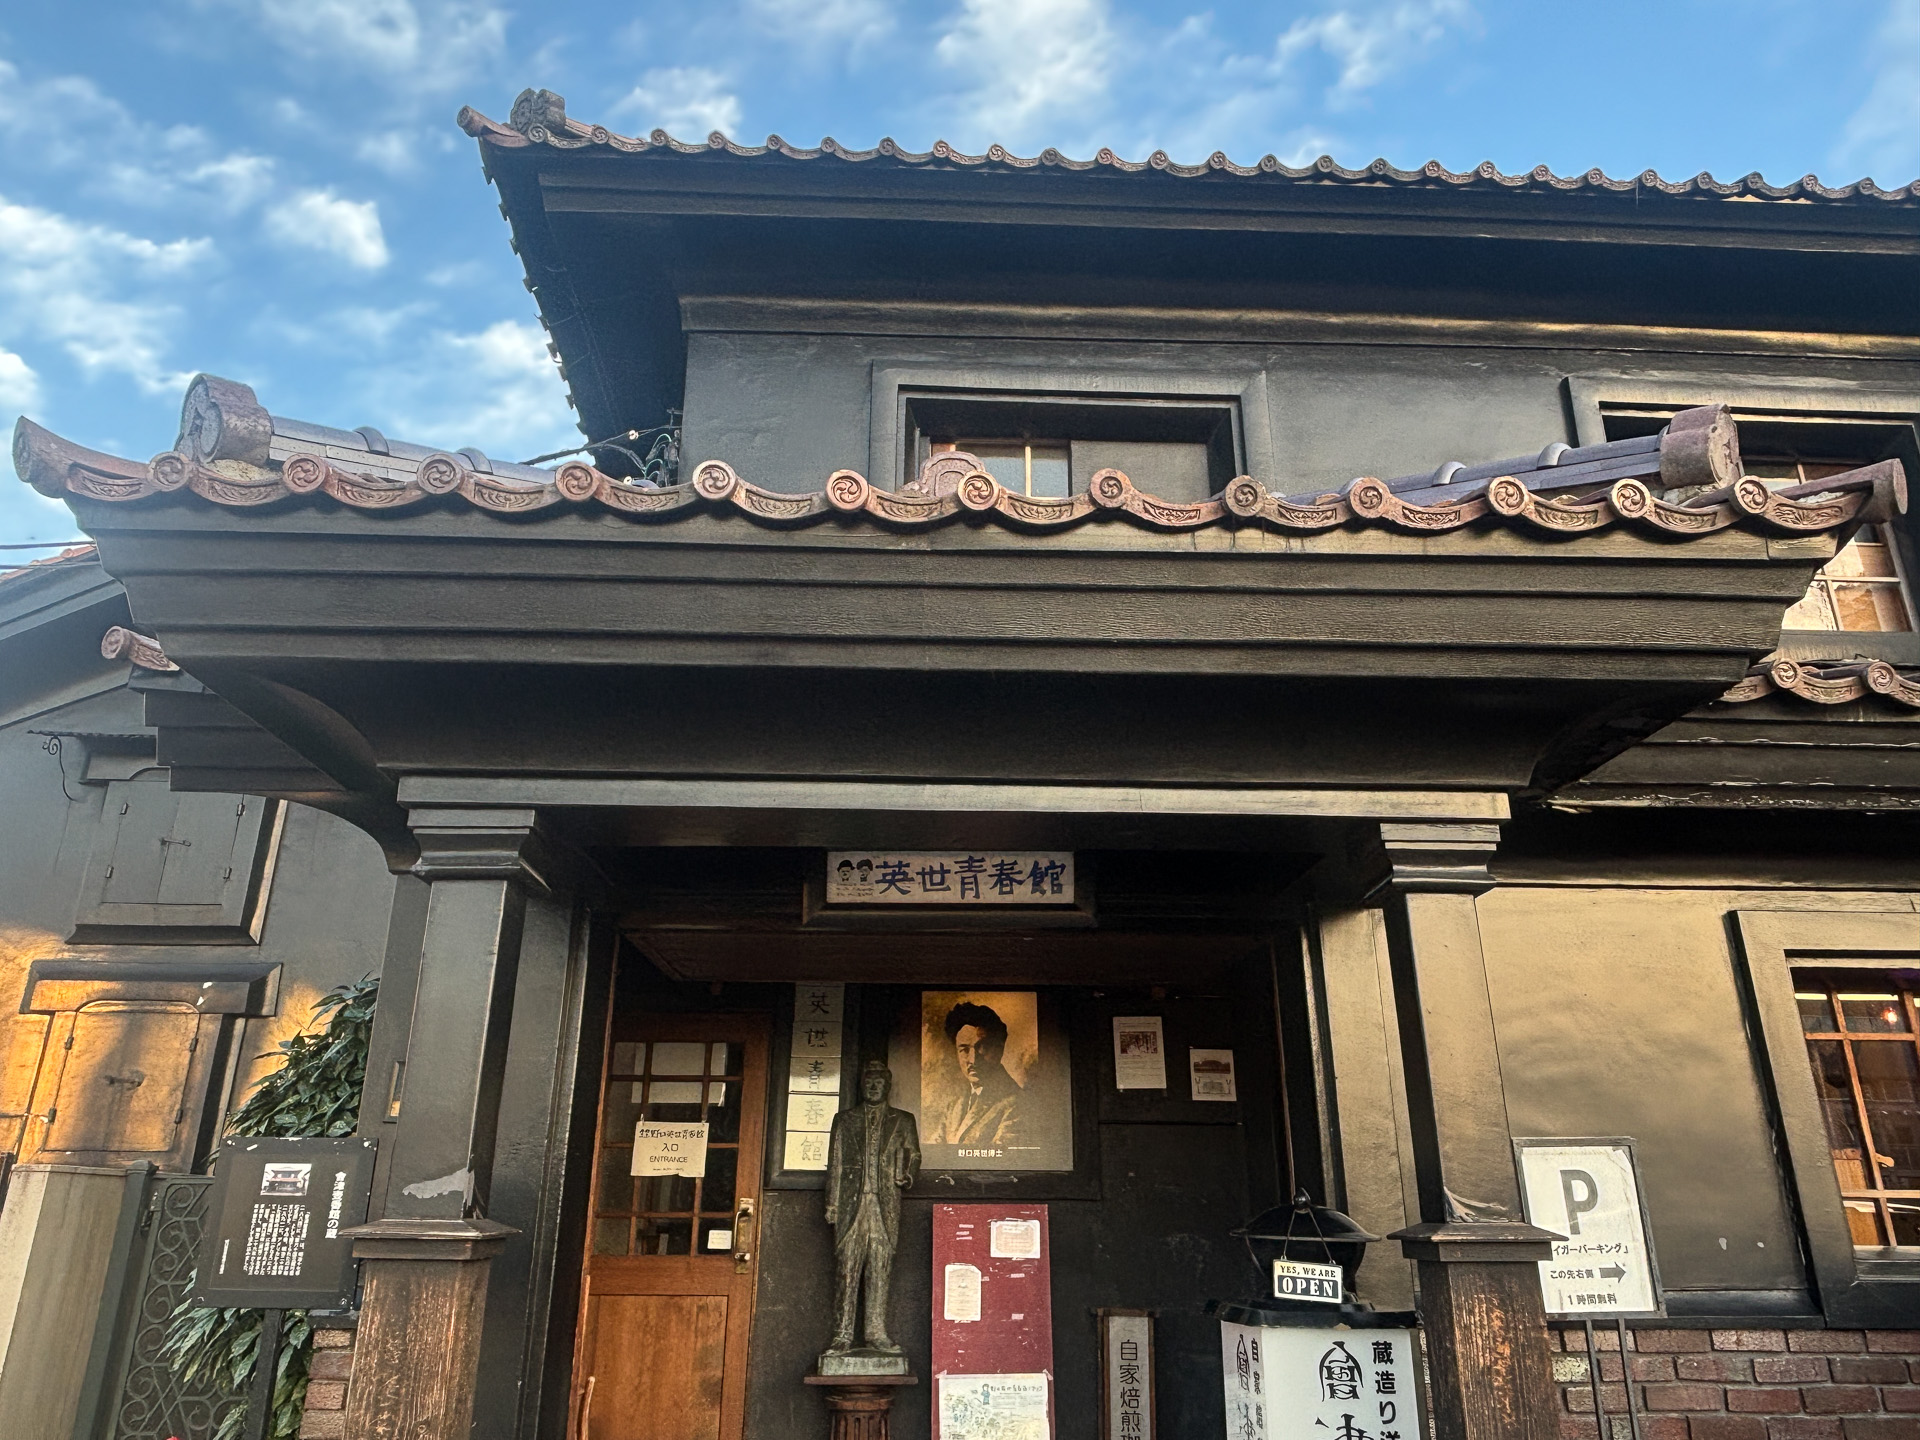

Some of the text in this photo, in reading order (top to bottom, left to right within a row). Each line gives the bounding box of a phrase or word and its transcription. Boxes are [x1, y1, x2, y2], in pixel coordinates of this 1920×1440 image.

[875, 855, 1066, 900] 英世青春館
[800, 991, 830, 1162] 英世青春館
[661, 1142, 679, 1152] 入口
[649, 1155, 688, 1163] ENTRANCE
[1560, 1169, 1599, 1235] P
[1280, 1265, 1336, 1278] YES, WE ARE
[1550, 1269, 1594, 1279] この先右側
[1282, 1277, 1334, 1297] OPEN
